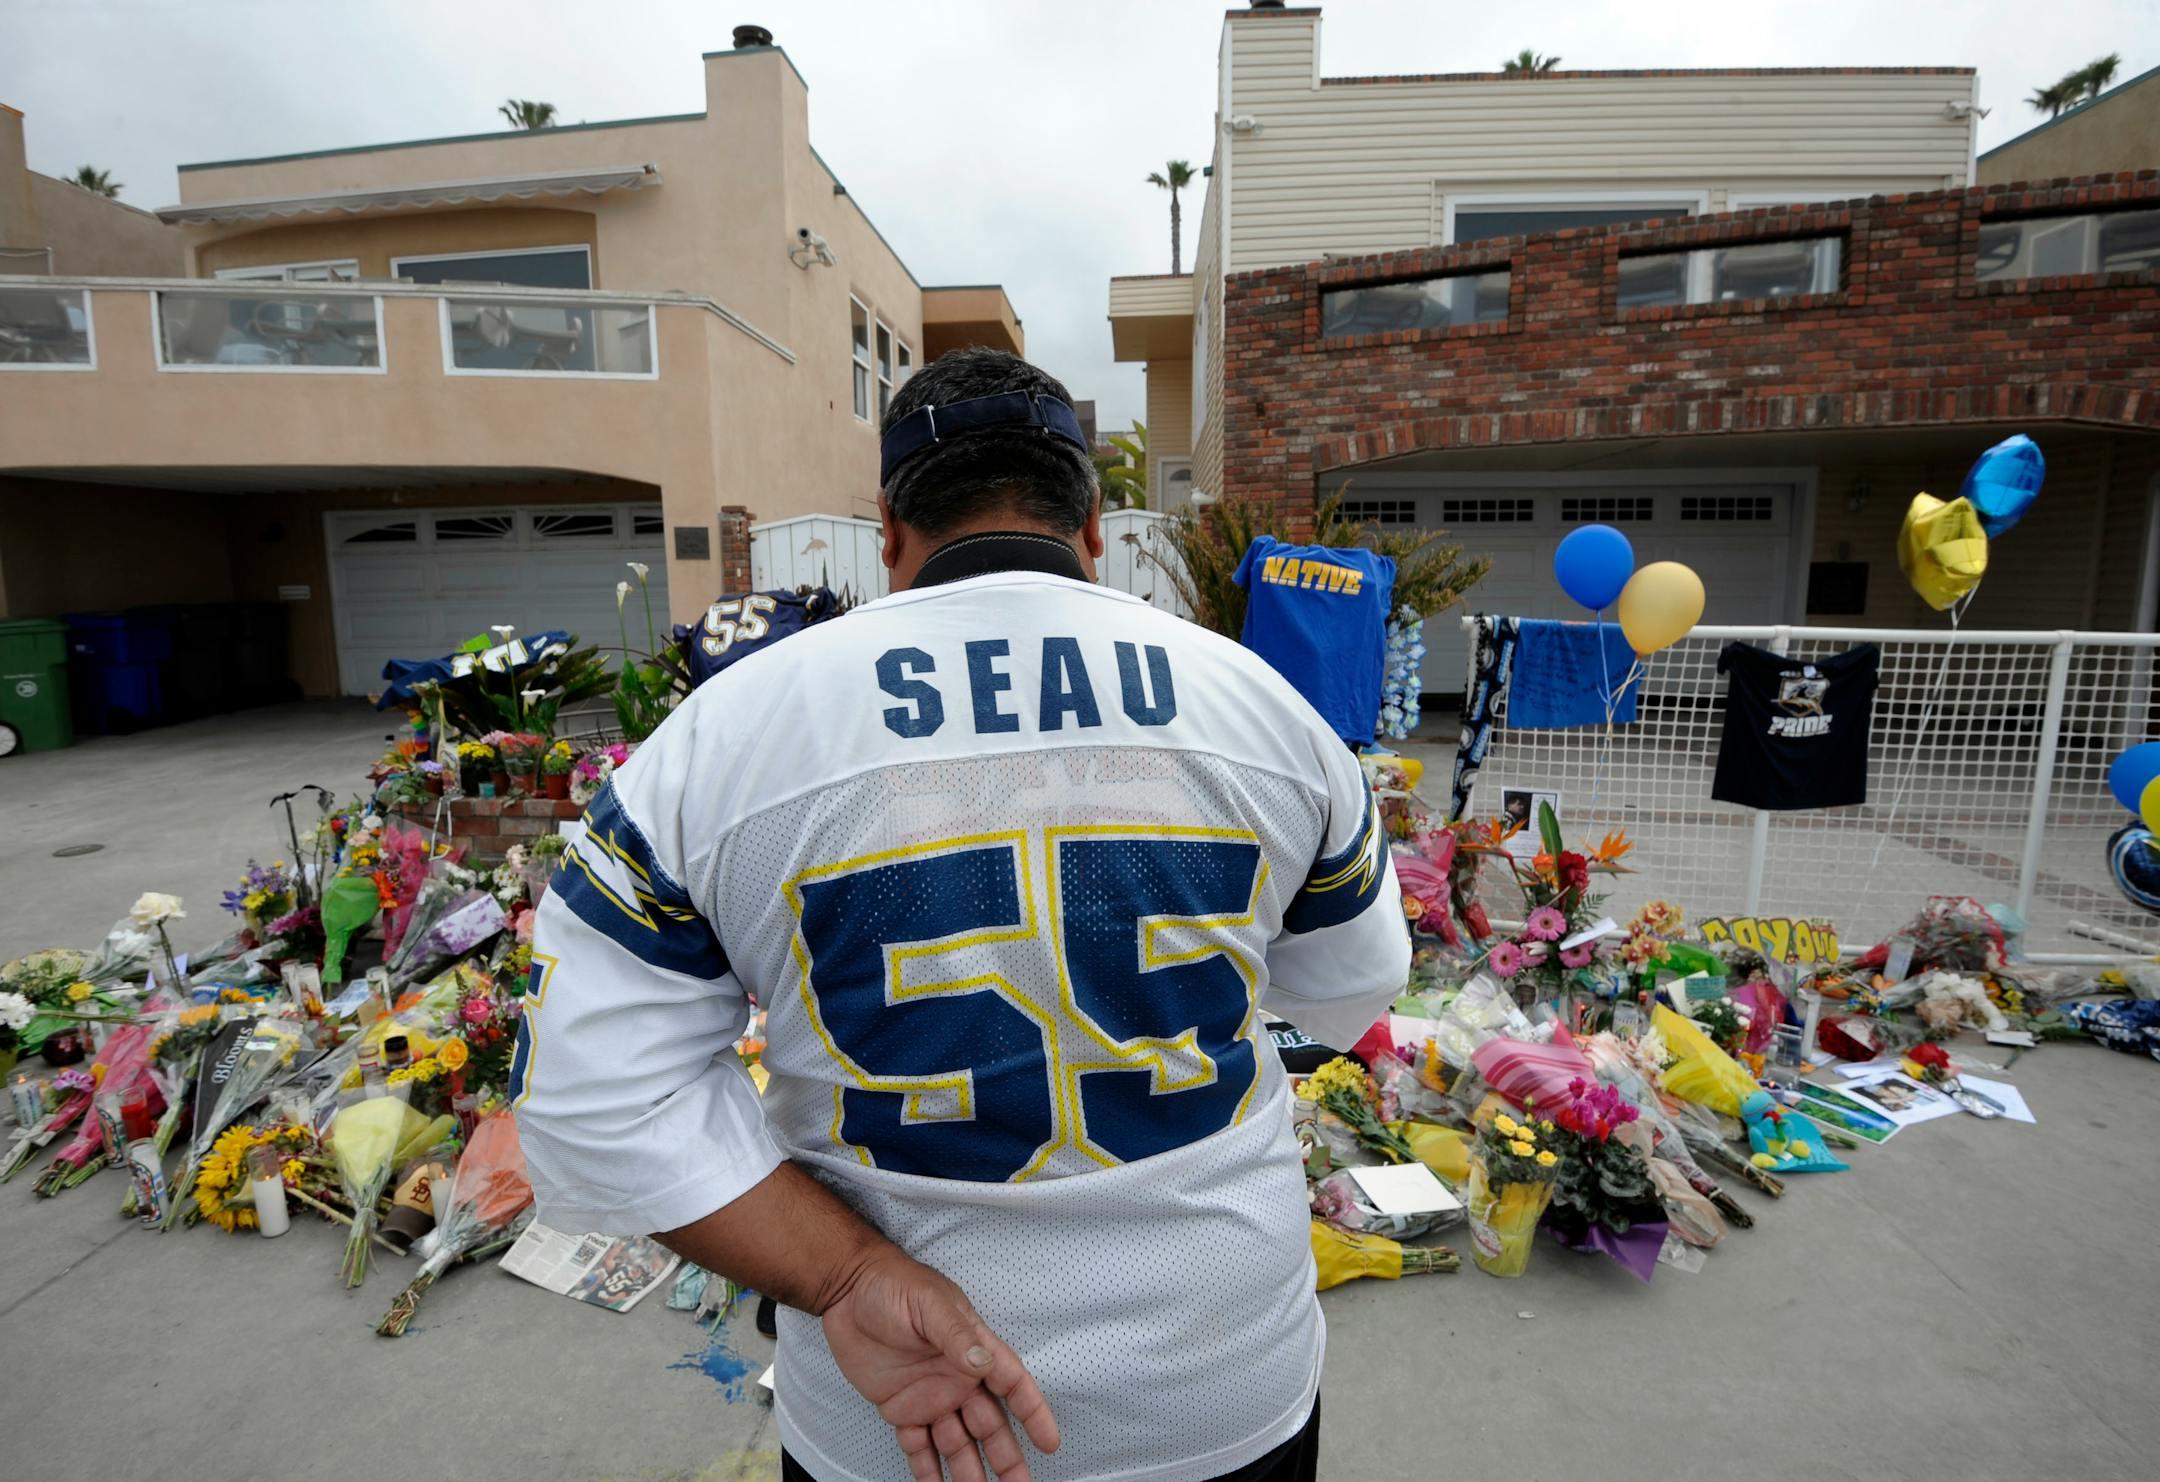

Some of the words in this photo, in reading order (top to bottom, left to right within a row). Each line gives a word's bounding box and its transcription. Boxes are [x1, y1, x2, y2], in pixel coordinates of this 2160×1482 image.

[1261, 556, 1364, 595] NATIVE
[702, 595, 777, 657] 55
[875, 637, 1177, 738] SEAU
[1767, 714, 1833, 737] PRIDE
[781, 825, 1269, 1184] 55
[211, 1027, 253, 1084] Blooms
